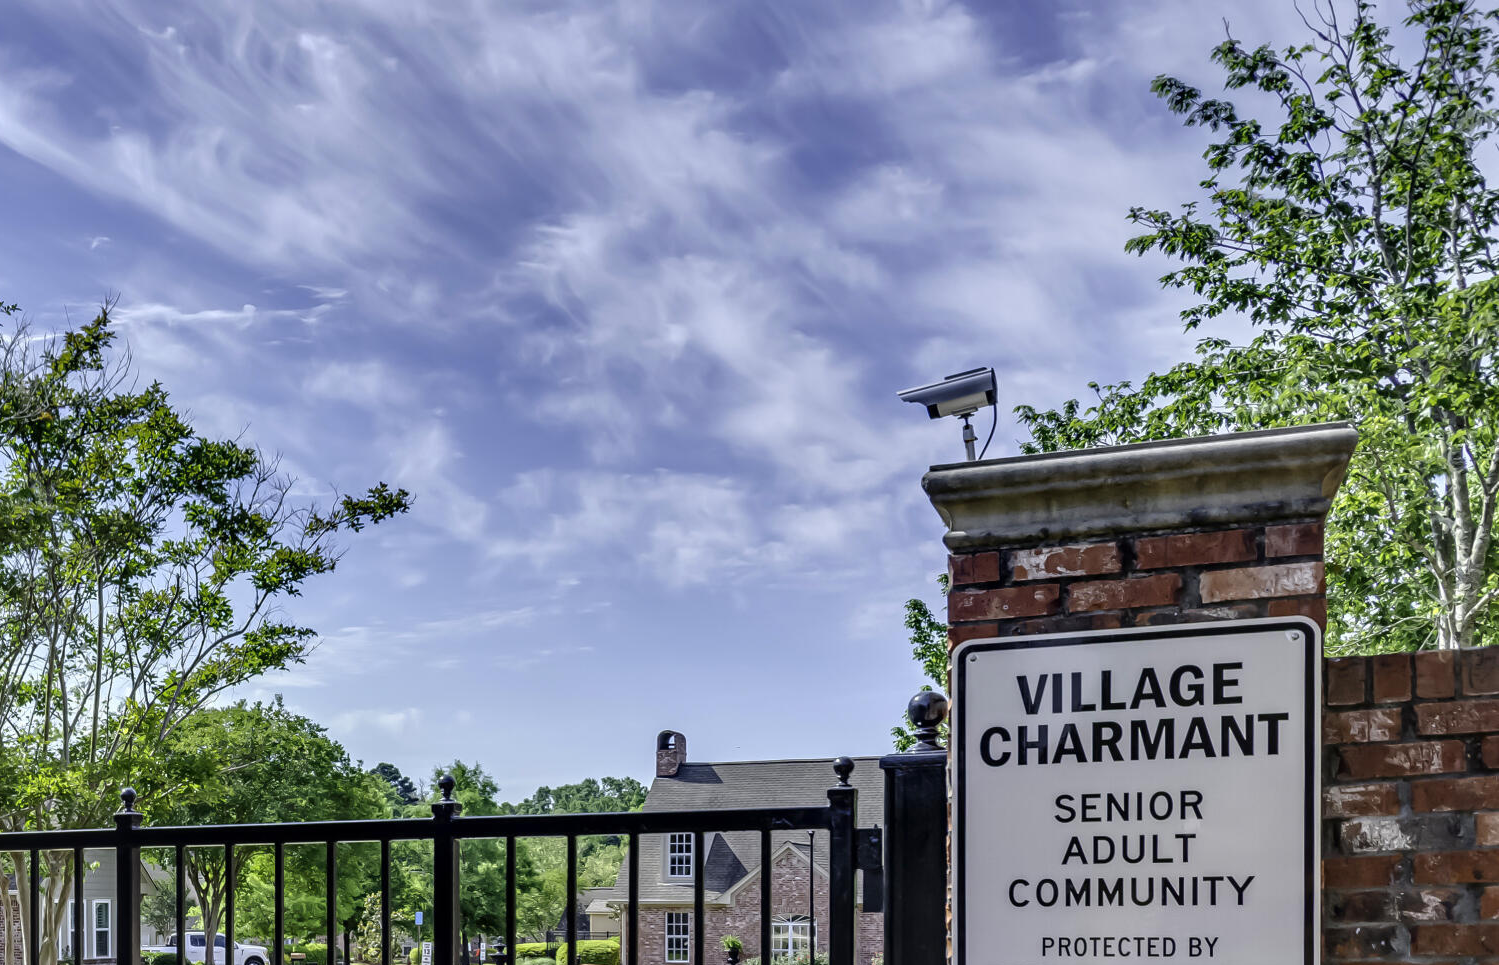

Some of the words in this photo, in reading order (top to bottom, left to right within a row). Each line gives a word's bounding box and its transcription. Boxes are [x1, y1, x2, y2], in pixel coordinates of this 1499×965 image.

[1016, 662, 1243, 715] VILLAGE
[980, 712, 1289, 767] CHARMANT
[1054, 790, 1204, 823] SENIOR
[1061, 833, 1197, 865] ADULT
[1008, 876, 1255, 908] COMMUNITY
[1042, 937, 1176, 957] PROTECTED
[1189, 937, 1219, 957] BY
